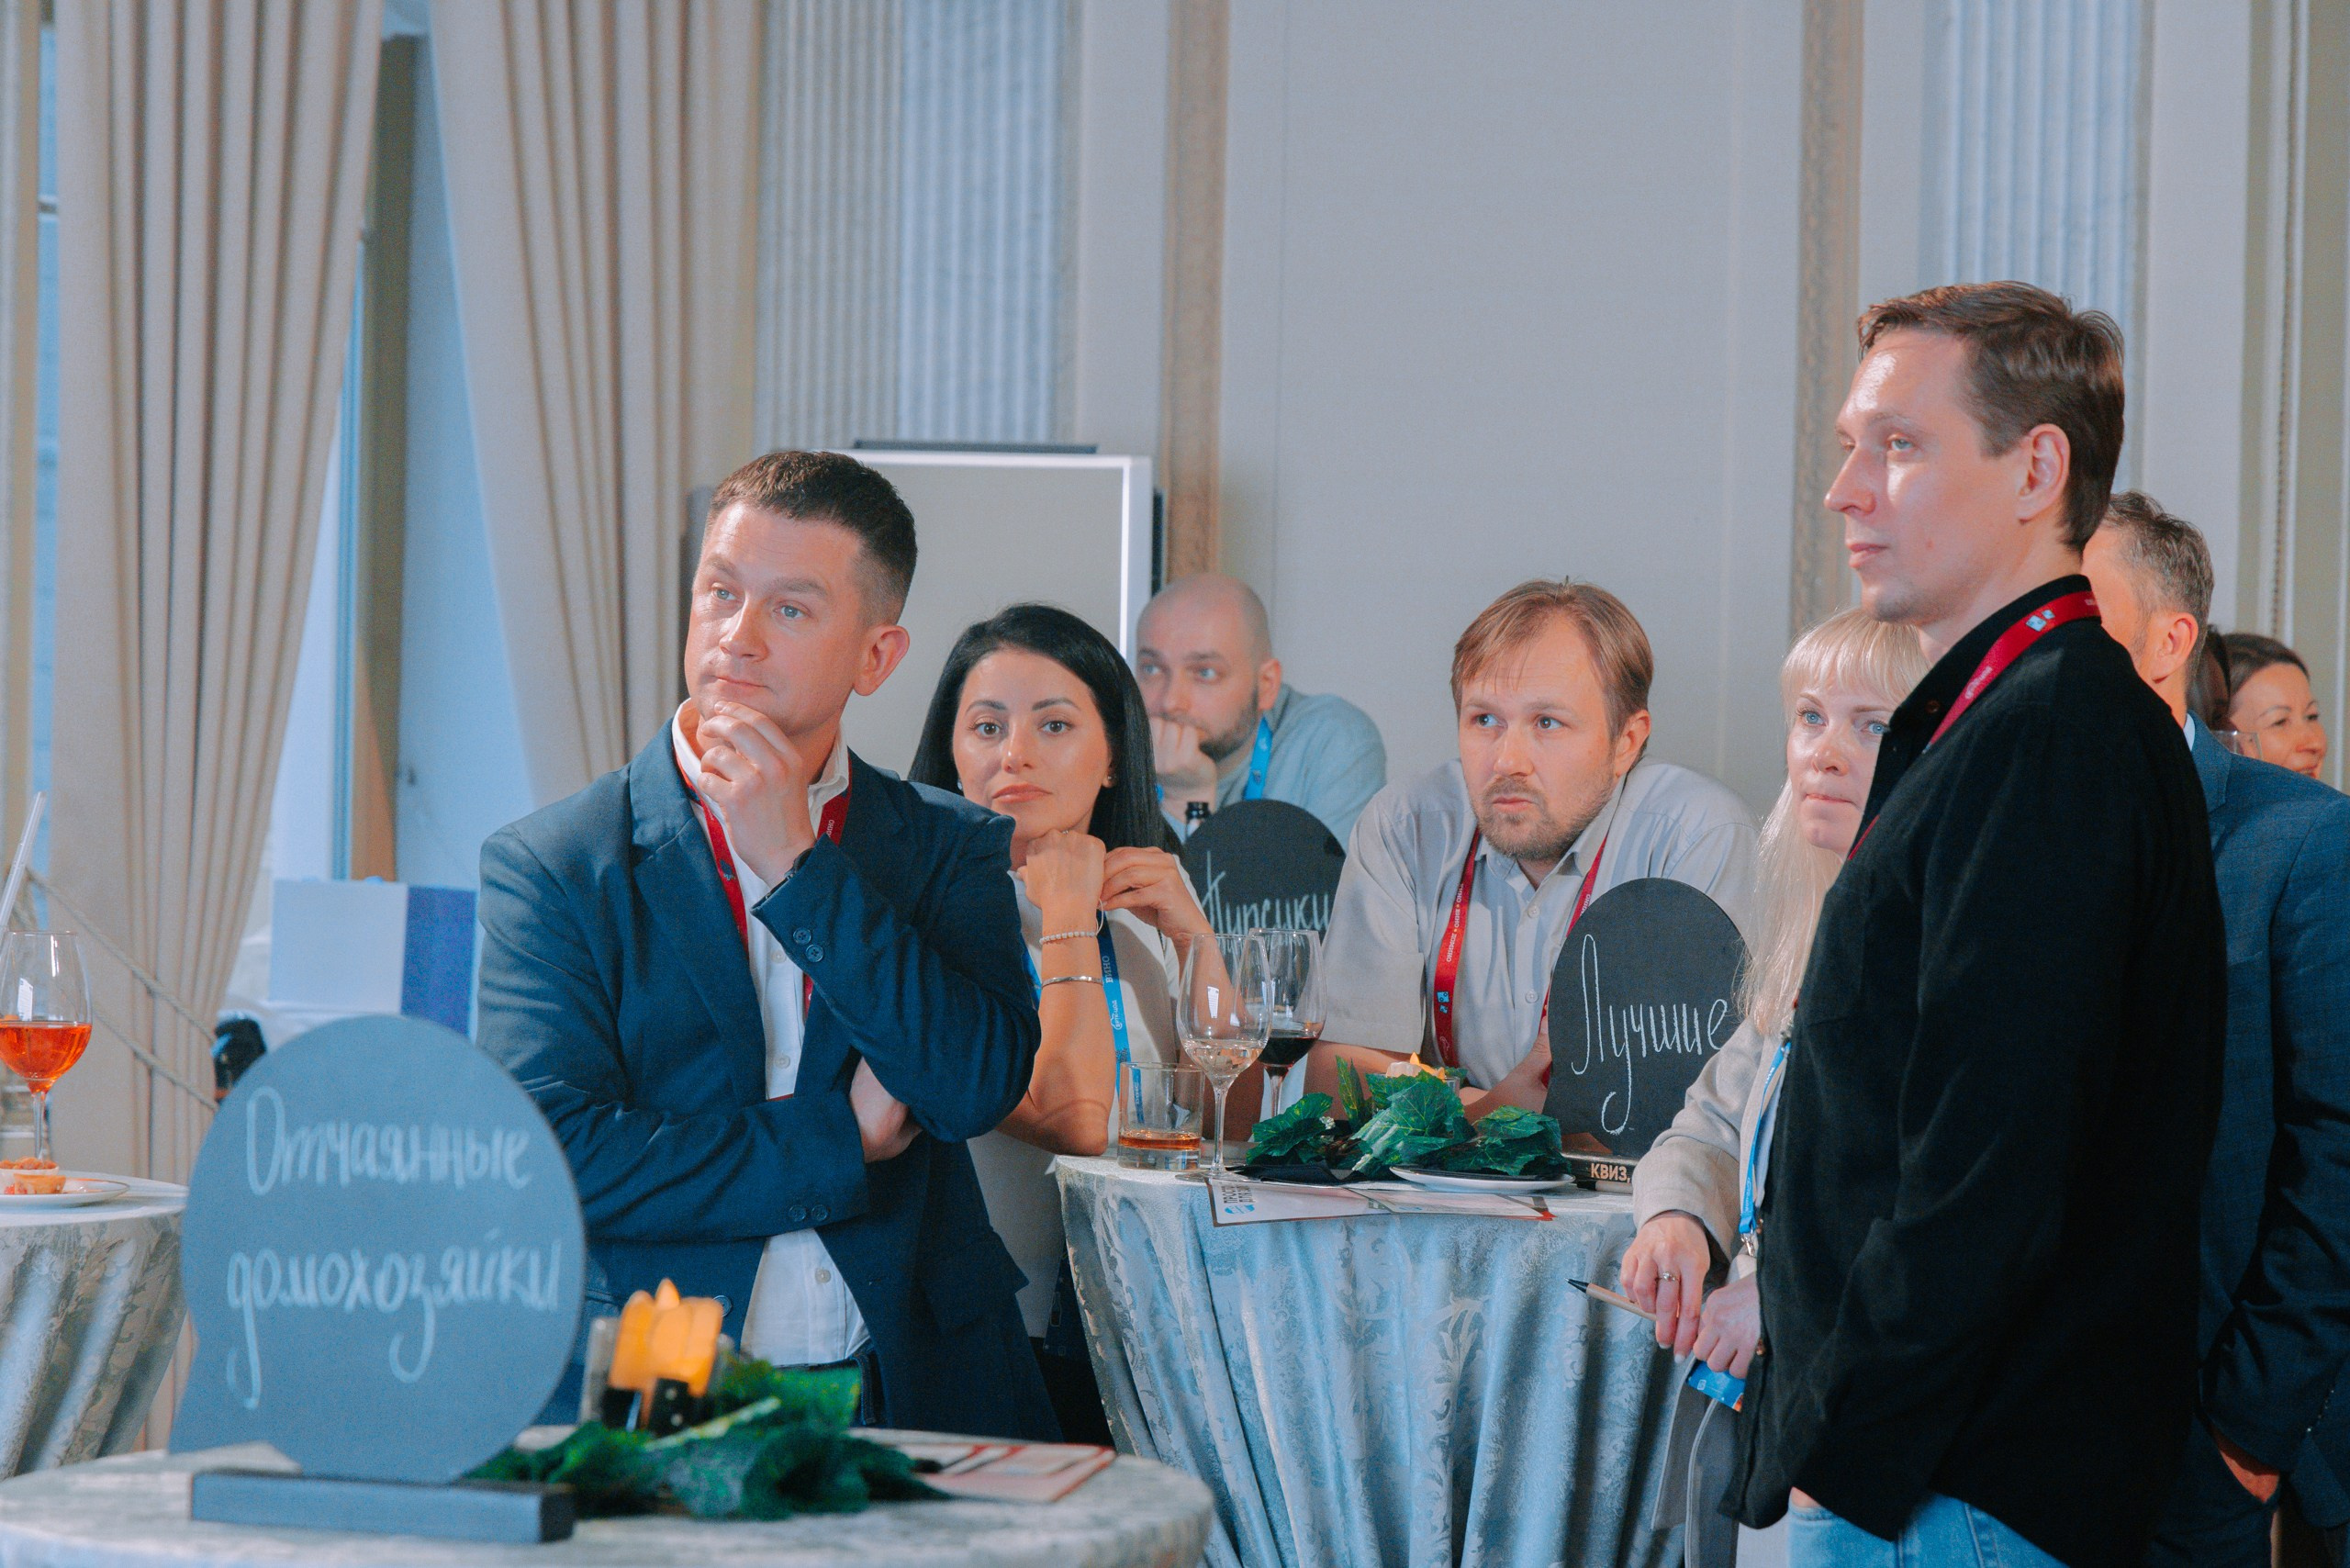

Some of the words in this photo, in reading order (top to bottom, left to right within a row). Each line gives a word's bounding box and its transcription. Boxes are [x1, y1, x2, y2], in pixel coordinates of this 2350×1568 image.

[1102, 955, 1114, 984] ВИНО
[1571, 933, 1728, 1136] Лучшие
[246, 1086, 532, 1195] Отчаянные
[1590, 1162, 1631, 1184] КВИЗ,
[226, 1227, 562, 1410] домохозяйки
